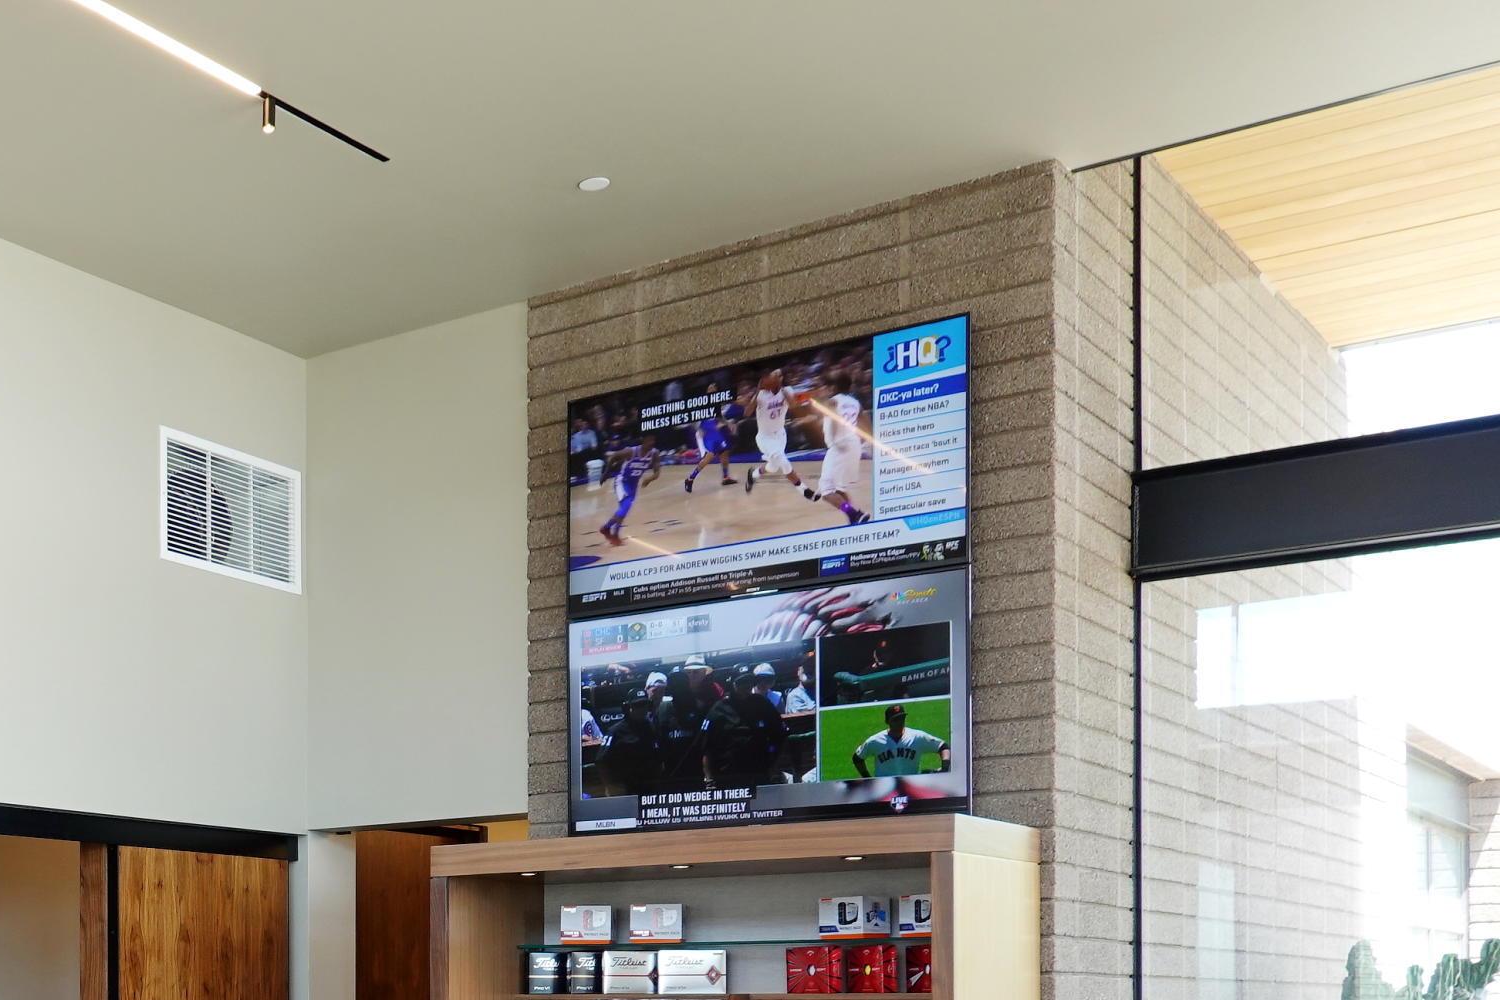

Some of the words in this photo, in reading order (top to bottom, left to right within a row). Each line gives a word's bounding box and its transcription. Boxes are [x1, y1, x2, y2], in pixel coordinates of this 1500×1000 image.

[913, 383, 939, 397] later?
[641, 400, 686, 419] SOMETHING
[687, 395, 709, 408] GOOD
[710, 390, 733, 403] HERE.
[900, 407, 911, 417] for
[913, 405, 926, 414] the
[927, 400, 950, 411] NBA?
[641, 416, 670, 431] UNLESS
[671, 412, 689, 425] HE'S
[903, 425, 916, 434] the
[917, 422, 935, 432] hero
[900, 445, 912, 454] not
[880, 465, 913, 476] Manager
[879, 484, 904, 495] Surfin
[905, 481, 922, 491] USA
[879, 500, 926, 515] Spectacular
[928, 497, 947, 506] save
[610, 570, 636, 581] WOULD
[637, 570, 642, 578] A
[643, 567, 658, 576] CP3
[660, 564, 674, 573] FOR
[676, 559, 708, 571] ANDREW
[710, 554, 743, 566] WIGGINS
[745, 549, 767, 561] SWAP
[768, 546, 791, 557] MAKE
[792, 541, 819, 553] SENSE
[821, 537, 838, 548] FOR
[840, 534, 870, 546] EITHER
[872, 528, 901, 540] TEAM?
[633, 586, 649, 594] Cubs
[650, 582, 670, 593] option
[670, 578, 696, 588] Addison
[697, 574, 720, 584] Russell
[902, 670, 925, 682] BANK
[927, 668, 938, 677] OF
[641, 794, 657, 806] BUT
[658, 794, 666, 804] IT
[668, 793, 683, 804] DID
[684, 791, 712, 803] WEDGE
[713, 789, 722, 800] IN
[724, 788, 753, 800] THERE.
[646, 807, 671, 819] MEAN,
[672, 806, 681, 817] IT
[681, 805, 700, 816] WAS
[701, 802, 747, 815] DEFINITELY
[752, 810, 784, 819] TWITTER
[595, 820, 616, 829] MLBN
[610, 956, 648, 968] Titleist
